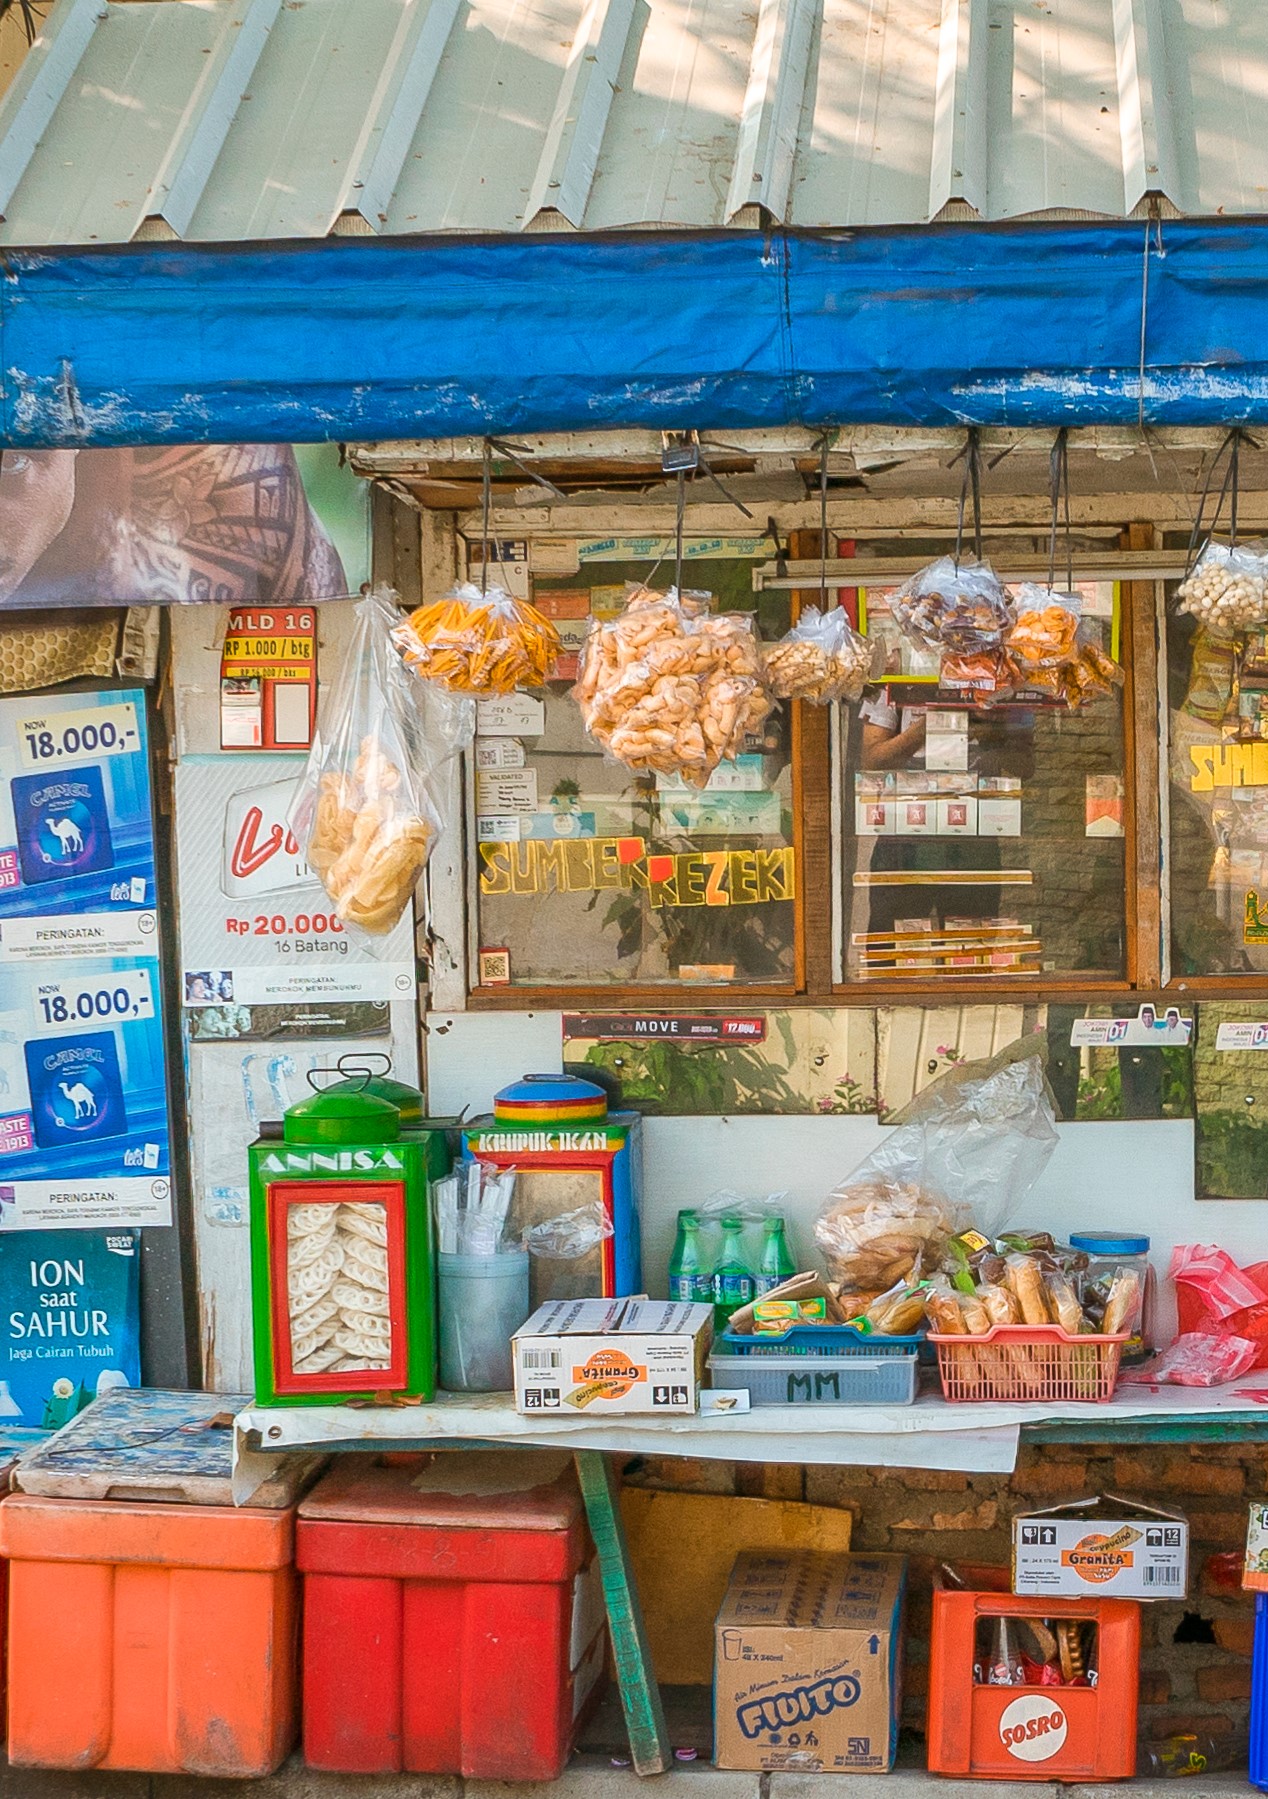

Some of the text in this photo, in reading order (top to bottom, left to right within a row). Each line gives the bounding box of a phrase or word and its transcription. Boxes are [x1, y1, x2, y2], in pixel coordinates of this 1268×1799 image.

[227, 613, 312, 631] MLD 16
[225, 638, 311, 659] RP 1.000 / btg
[24, 719, 47, 731] NOW
[26, 721, 135, 760] 18.000,-
[30, 783, 92, 807] CAMEL
[479, 837, 649, 896] SUMBER
[648, 847, 796, 909] REZEKI
[226, 918, 249, 936] Rp
[275, 938, 349, 954] 16 Batang
[38, 984, 60, 995] NOW
[40, 987, 149, 1024] 18.000,-
[635, 1020, 679, 1033] MOVE
[1109, 1025, 1127, 1039] 01
[43, 1047, 105, 1071] CAMEL
[258, 1149, 404, 1173] ANNISA
[30, 1260, 85, 1287] ION
[40, 1291, 78, 1307] saat
[9, 1310, 110, 1339] SAHUR
[9, 1344, 114, 1362] Jaga Cairan Tubuh
[787, 1371, 840, 1402] MM
[527, 1396, 540, 1406] 12
[1166, 1529, 1179, 1539] 12
[734, 1658, 850, 1703] Air Minum Dalam Kemasan
[1002, 1710, 1064, 1749] SOSRO
